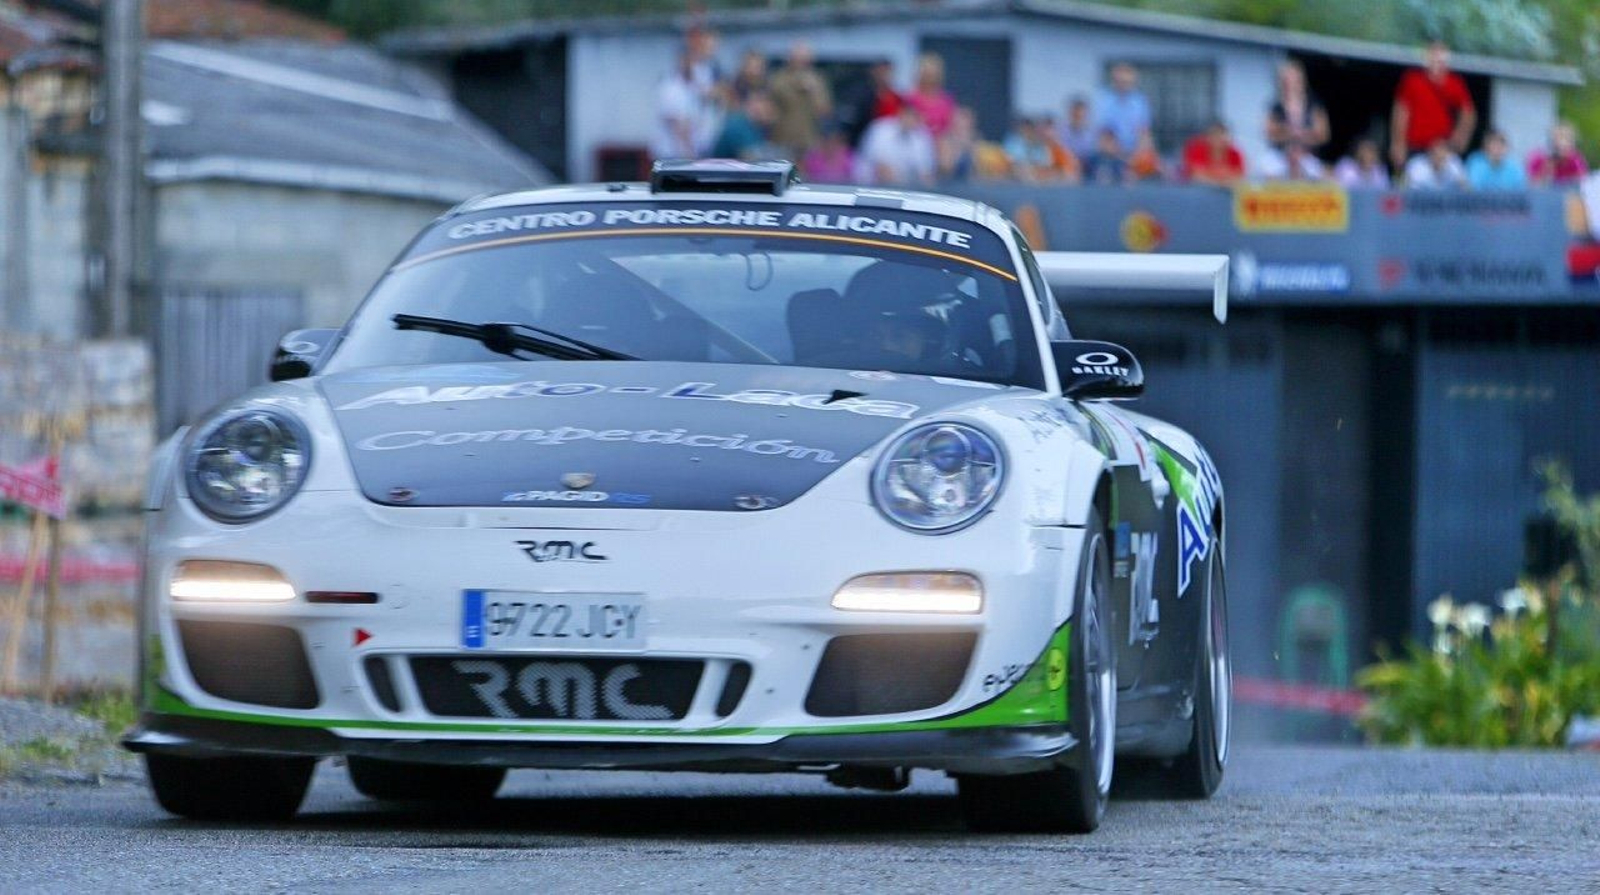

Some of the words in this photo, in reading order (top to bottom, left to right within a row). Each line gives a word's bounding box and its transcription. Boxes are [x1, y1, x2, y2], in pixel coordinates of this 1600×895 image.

[448, 210, 597, 240] CENTRO
[602, 208, 783, 227] PORSCHE
[787, 212, 973, 250] ALICANTE
[354, 426, 841, 463] Competición
[486, 602, 572, 638] 9722
